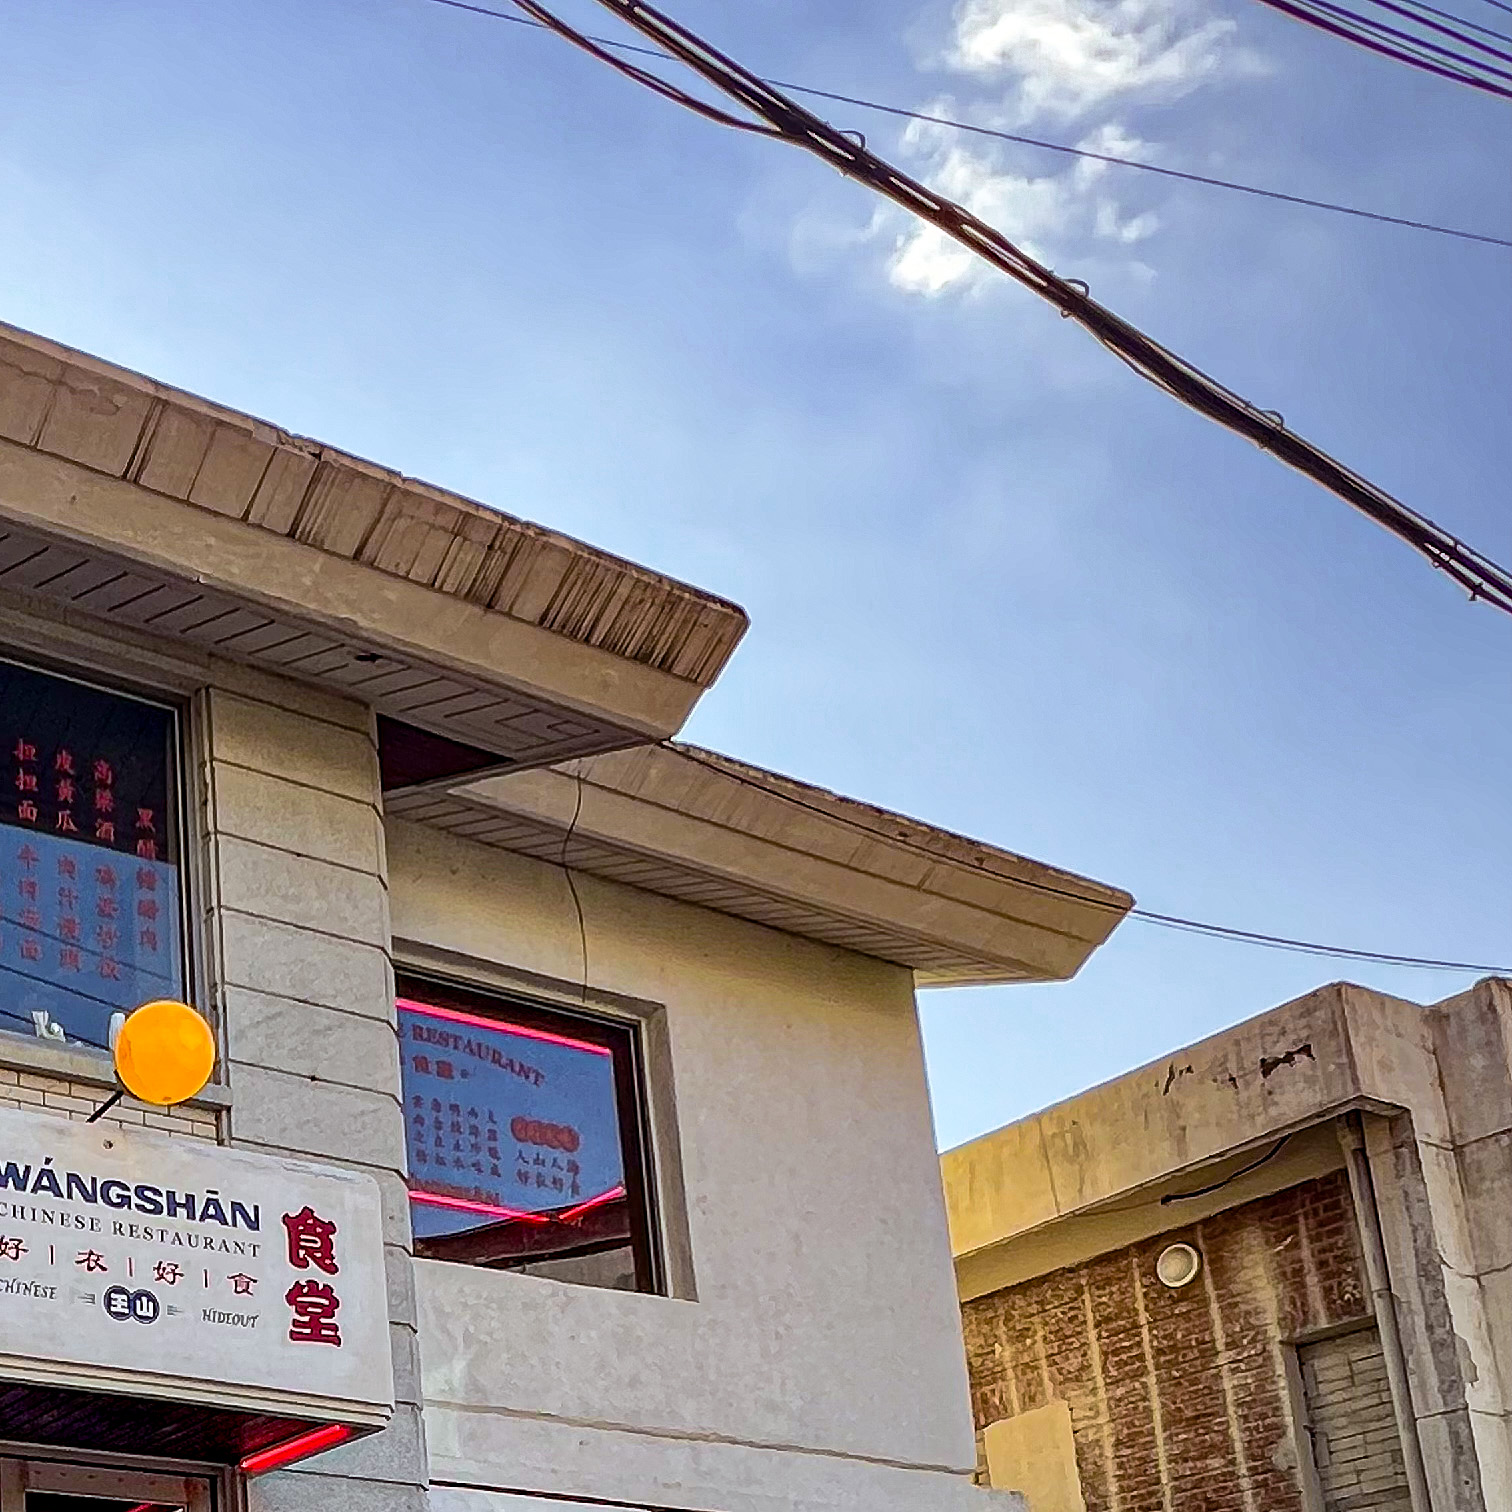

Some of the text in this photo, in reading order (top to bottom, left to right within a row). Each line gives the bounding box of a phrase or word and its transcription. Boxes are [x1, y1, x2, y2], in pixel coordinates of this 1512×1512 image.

[411, 1023, 545, 1088] RESTAURANT
[112, 1220, 261, 1258] RESTAURANT
[281, 1205, 343, 1348] 食堂
[201, 1306, 260, 1329] HIDEOUT
